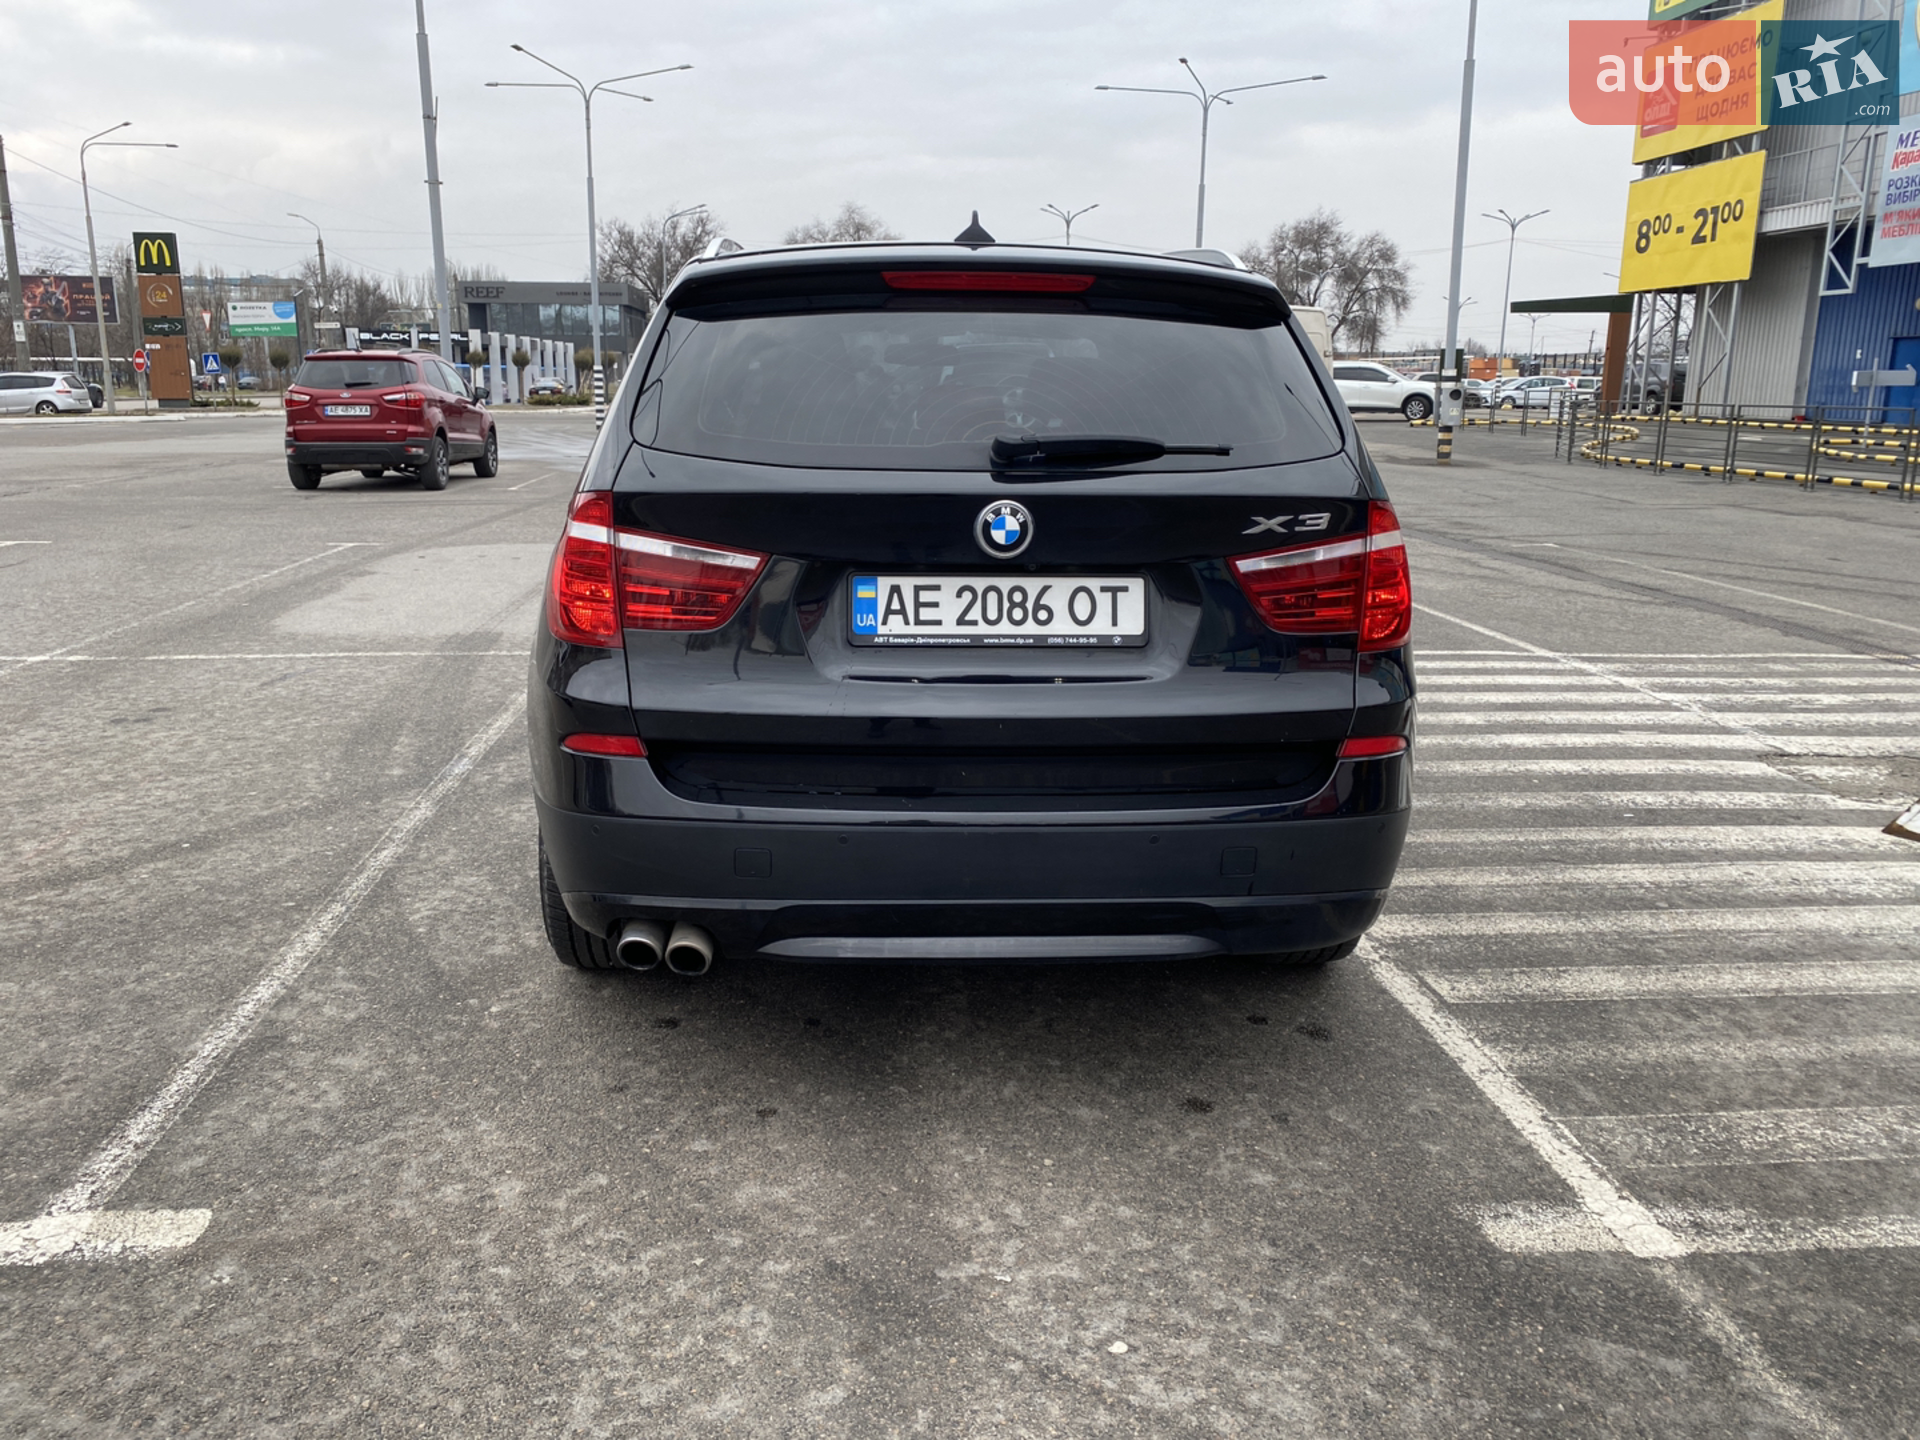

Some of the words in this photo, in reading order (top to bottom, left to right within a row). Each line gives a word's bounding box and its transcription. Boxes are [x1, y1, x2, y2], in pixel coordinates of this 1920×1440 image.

[1695, 92, 1750, 122] ЩОДНЯ
[464, 286, 505, 298] REEF
[360, 332, 410, 340] BLACK
[986, 506, 1026, 523] BMW
[1241, 512, 1331, 535] X3
[880, 584, 943, 627] AE
[955, 584, 1054, 627] 2086
[1067, 585, 1130, 627] OT
[856, 613, 876, 627] UA
